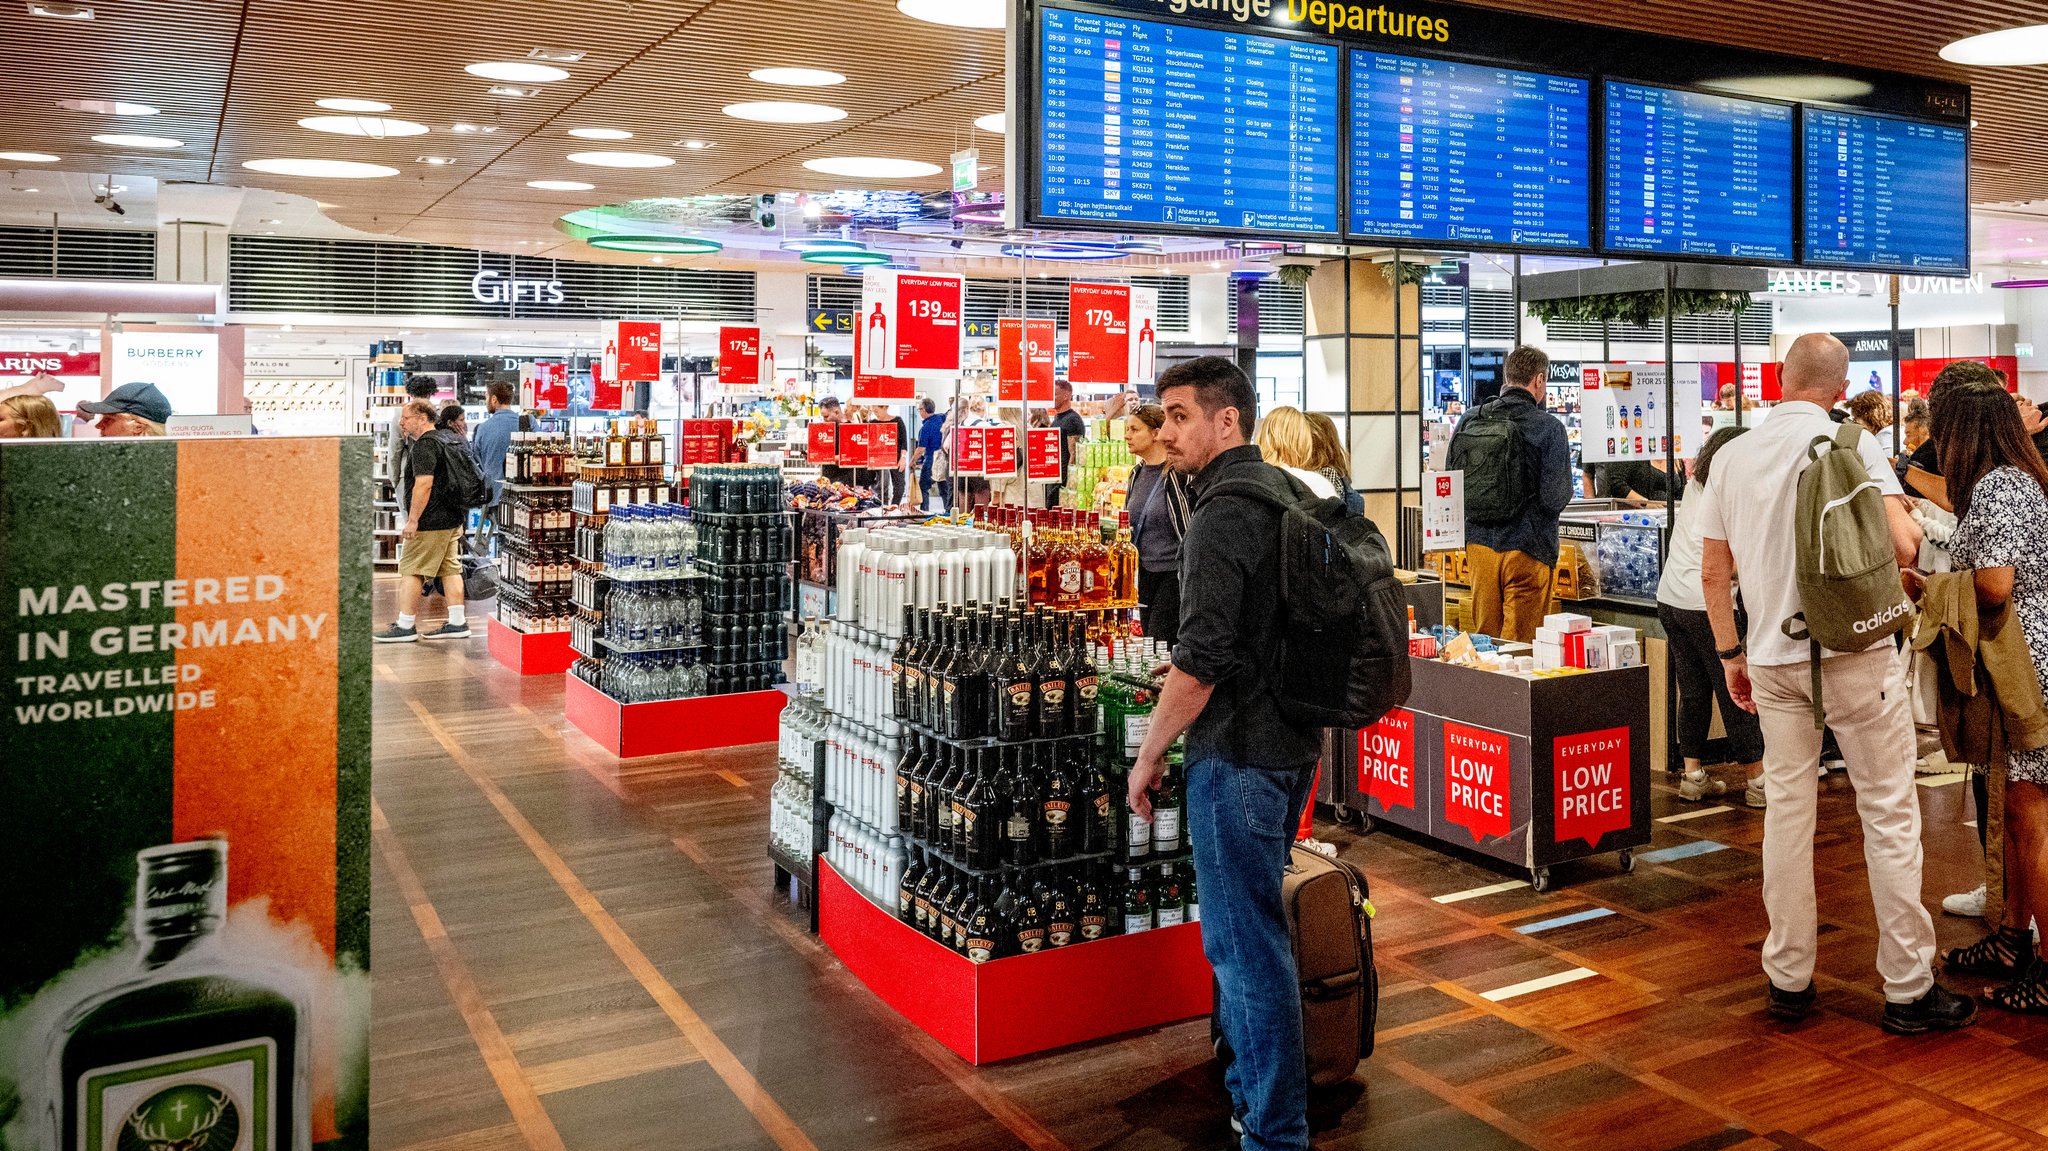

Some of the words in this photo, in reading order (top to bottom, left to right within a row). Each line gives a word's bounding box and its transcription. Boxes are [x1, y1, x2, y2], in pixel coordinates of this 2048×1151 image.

[1287, 0, 1449, 42] Departures
[1246, 90, 1268, 98] Boarding
[1246, 100, 1268, 108] Boarding
[471, 270, 565, 304] GIFTS
[900, 278, 928, 287] EVERYDAY
[1767, 271, 1861, 295] ANCES
[1872, 273, 1984, 295] WOMEN
[909, 300, 942, 318] 139
[1085, 310, 1113, 326] 179
[629, 336, 648, 347] 119
[730, 340, 748, 351] 179
[1855, 340, 1888, 352] ARMANI
[127, 347, 203, 358] BURBERRY
[851, 434, 861, 442] 49
[879, 434, 889, 442] 45
[1438, 482, 1450, 490] 149
[1567, 526, 1594, 536] CHOCOLATE
[18, 575, 284, 617] MASTERED
[1853, 600, 1909, 634] adidas
[18, 630, 69, 662] IN
[90, 613, 328, 656] GERMANY
[16, 664, 202, 696] TRAVELLED
[16, 690, 216, 726] WORLDWIDE
[1364, 731, 1400, 760] LOW
[1451, 734, 1502, 755] EVERYDAY
[1562, 738, 1622, 757] EVERYDAY
[1364, 756, 1408, 788] PRICE
[1451, 756, 1493, 786] LOW
[1562, 763, 1612, 792] LOW
[1452, 782, 1503, 817] PRICE
[1563, 788, 1623, 820] PRICE
